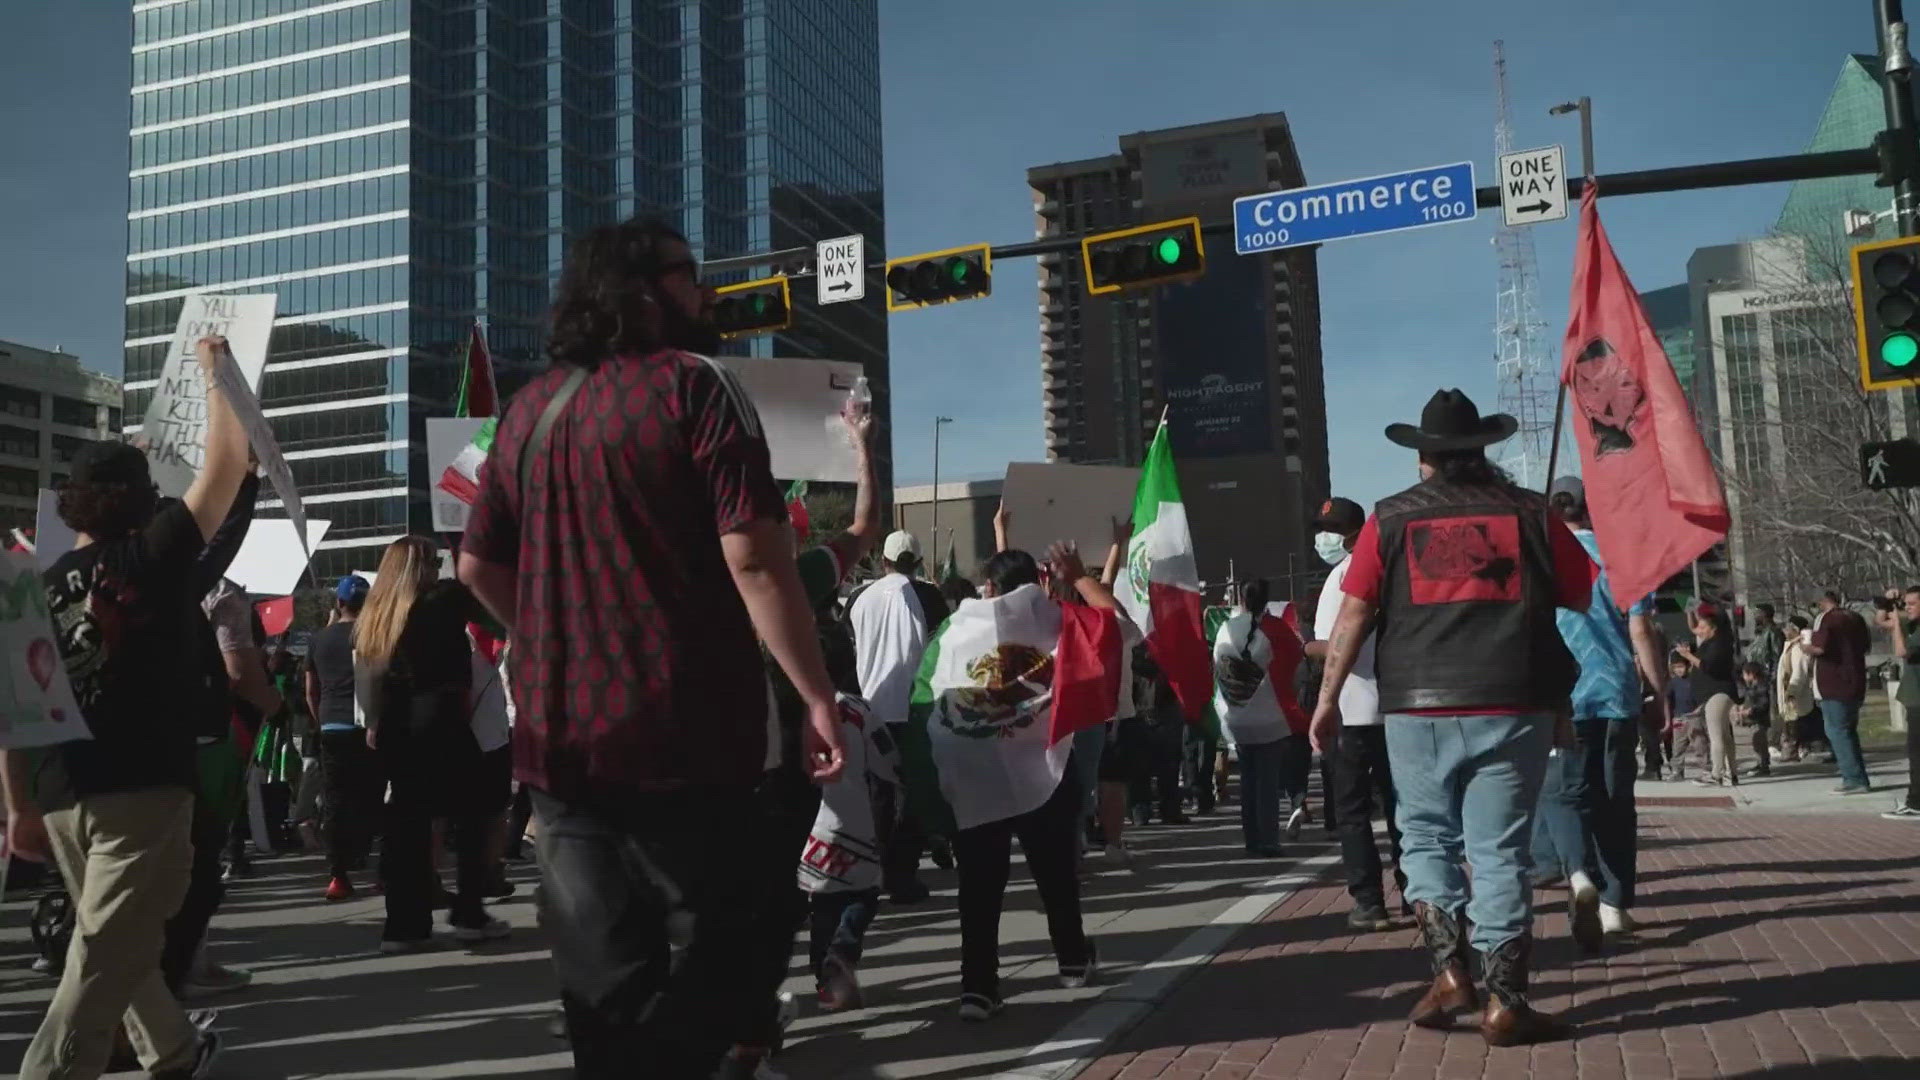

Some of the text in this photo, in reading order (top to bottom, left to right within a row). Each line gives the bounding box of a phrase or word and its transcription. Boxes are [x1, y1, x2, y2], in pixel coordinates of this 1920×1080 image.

[1510, 155, 1554, 177] ONE
[1509, 174, 1557, 197] WAY
[1253, 173, 1452, 227] Commerce
[1422, 200, 1466, 221] 1100
[1243, 228, 1290, 248] 1000
[825, 244, 855, 261] ONE
[823, 260, 857, 278] WAY
